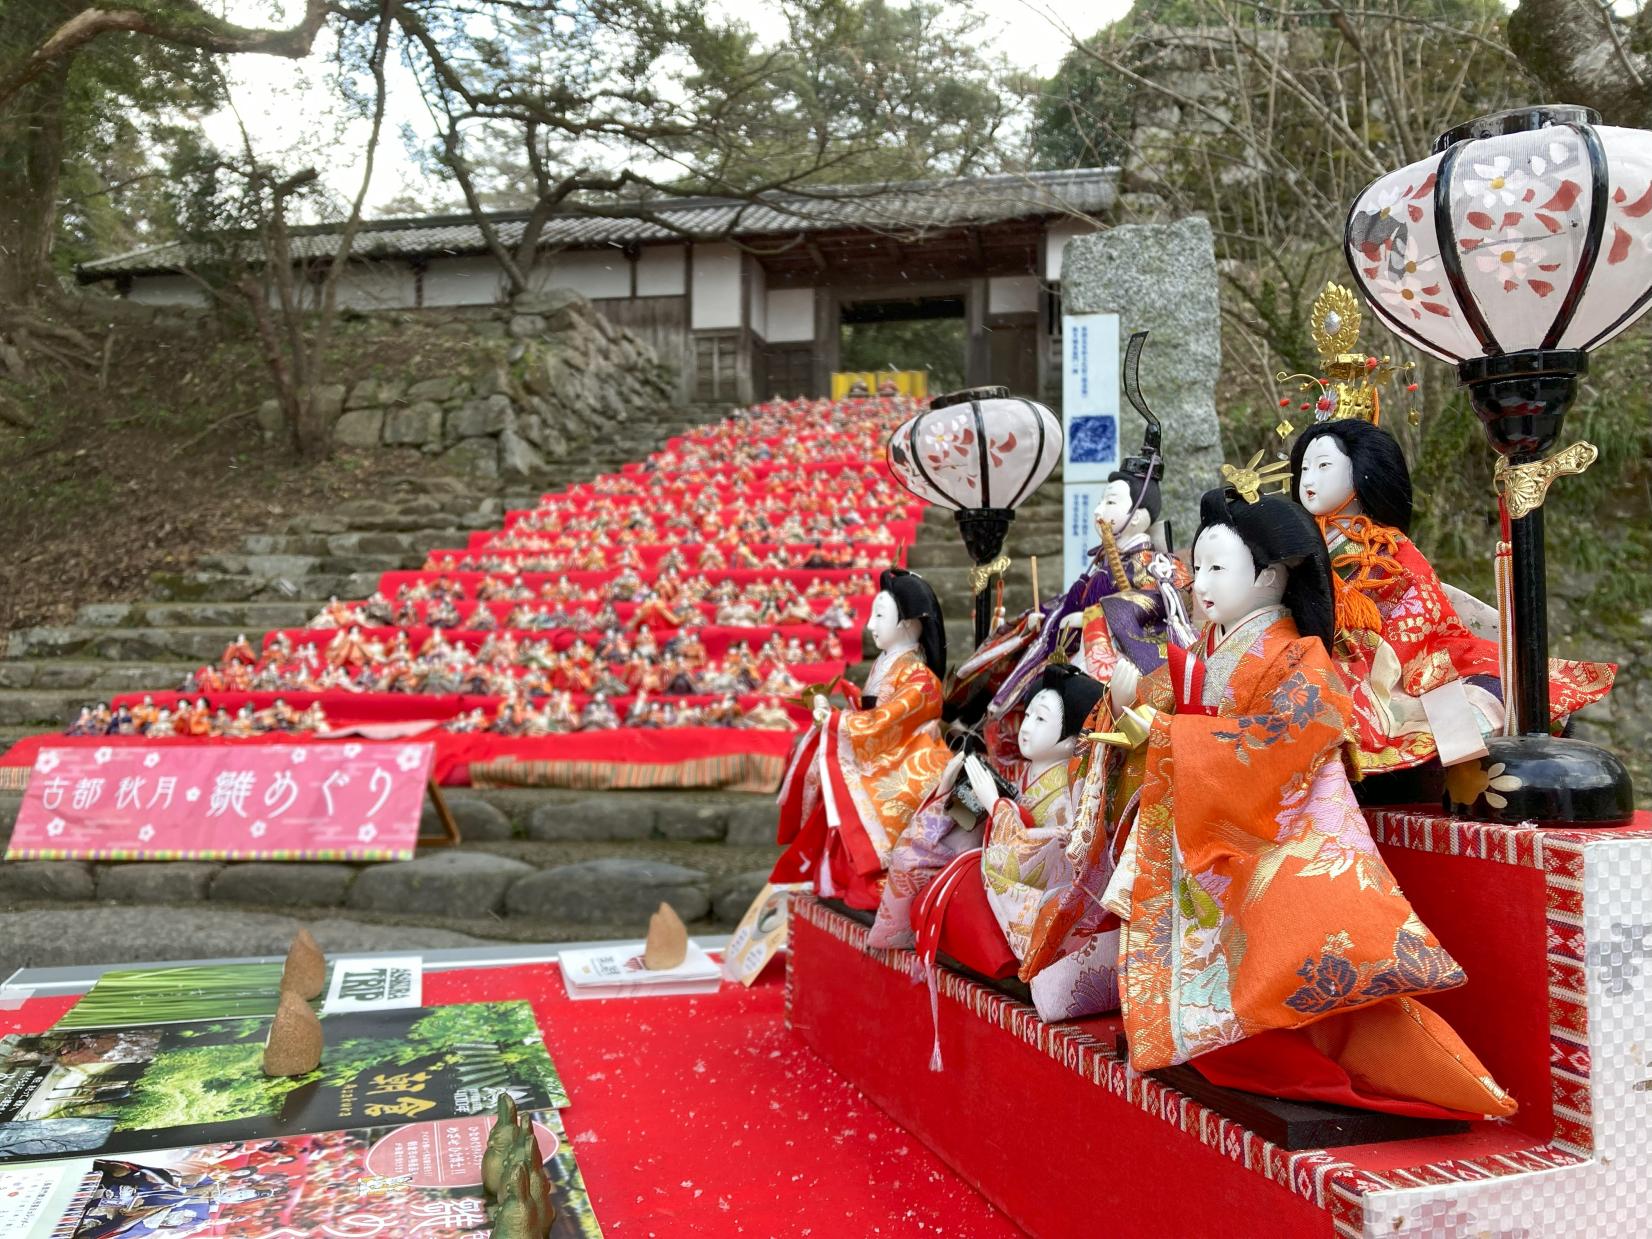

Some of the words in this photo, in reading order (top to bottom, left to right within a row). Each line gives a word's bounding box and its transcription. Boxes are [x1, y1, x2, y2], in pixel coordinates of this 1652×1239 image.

[42, 775, 106, 811] 古都
[114, 775, 178, 811] 秋月
[205, 766, 393, 819] 雛めぐり
[338, 968, 387, 1001] TRIP
[364, 1071, 438, 1118] 朝倉
